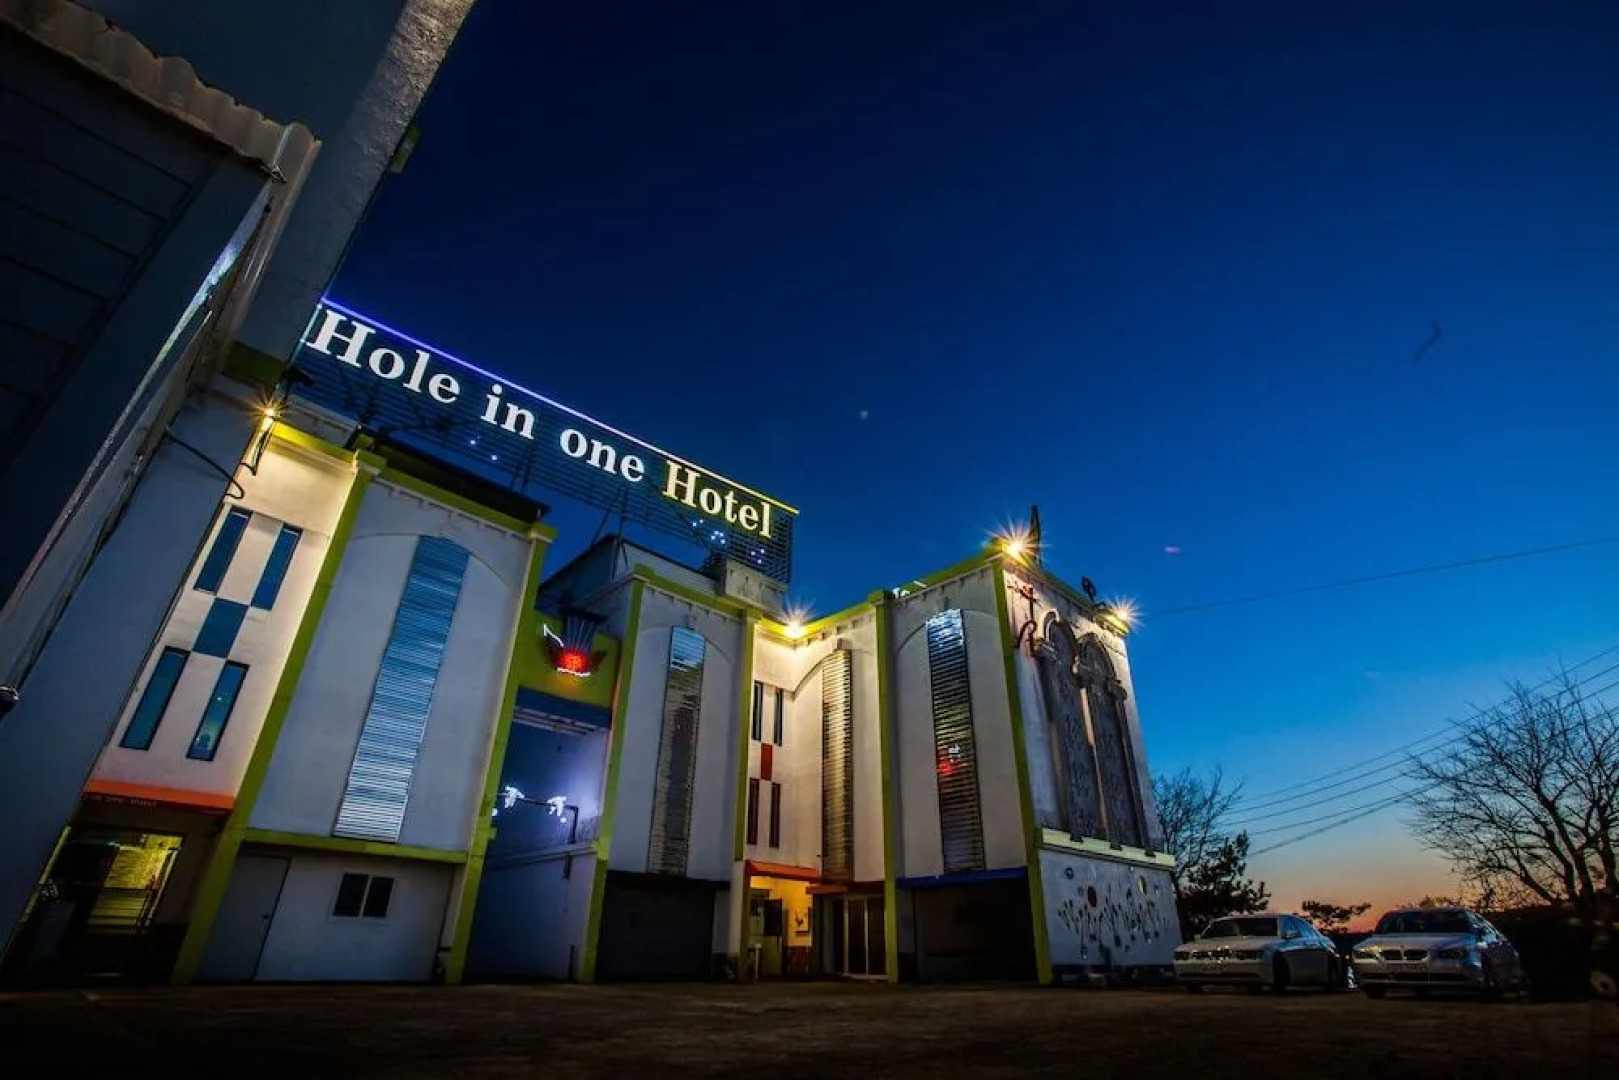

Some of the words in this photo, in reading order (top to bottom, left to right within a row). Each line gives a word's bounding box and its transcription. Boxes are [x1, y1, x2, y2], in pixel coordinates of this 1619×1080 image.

[305, 309, 461, 404] Hole
[480, 384, 535, 439] in
[560, 428, 645, 482] one
[662, 460, 771, 538] Hotel
